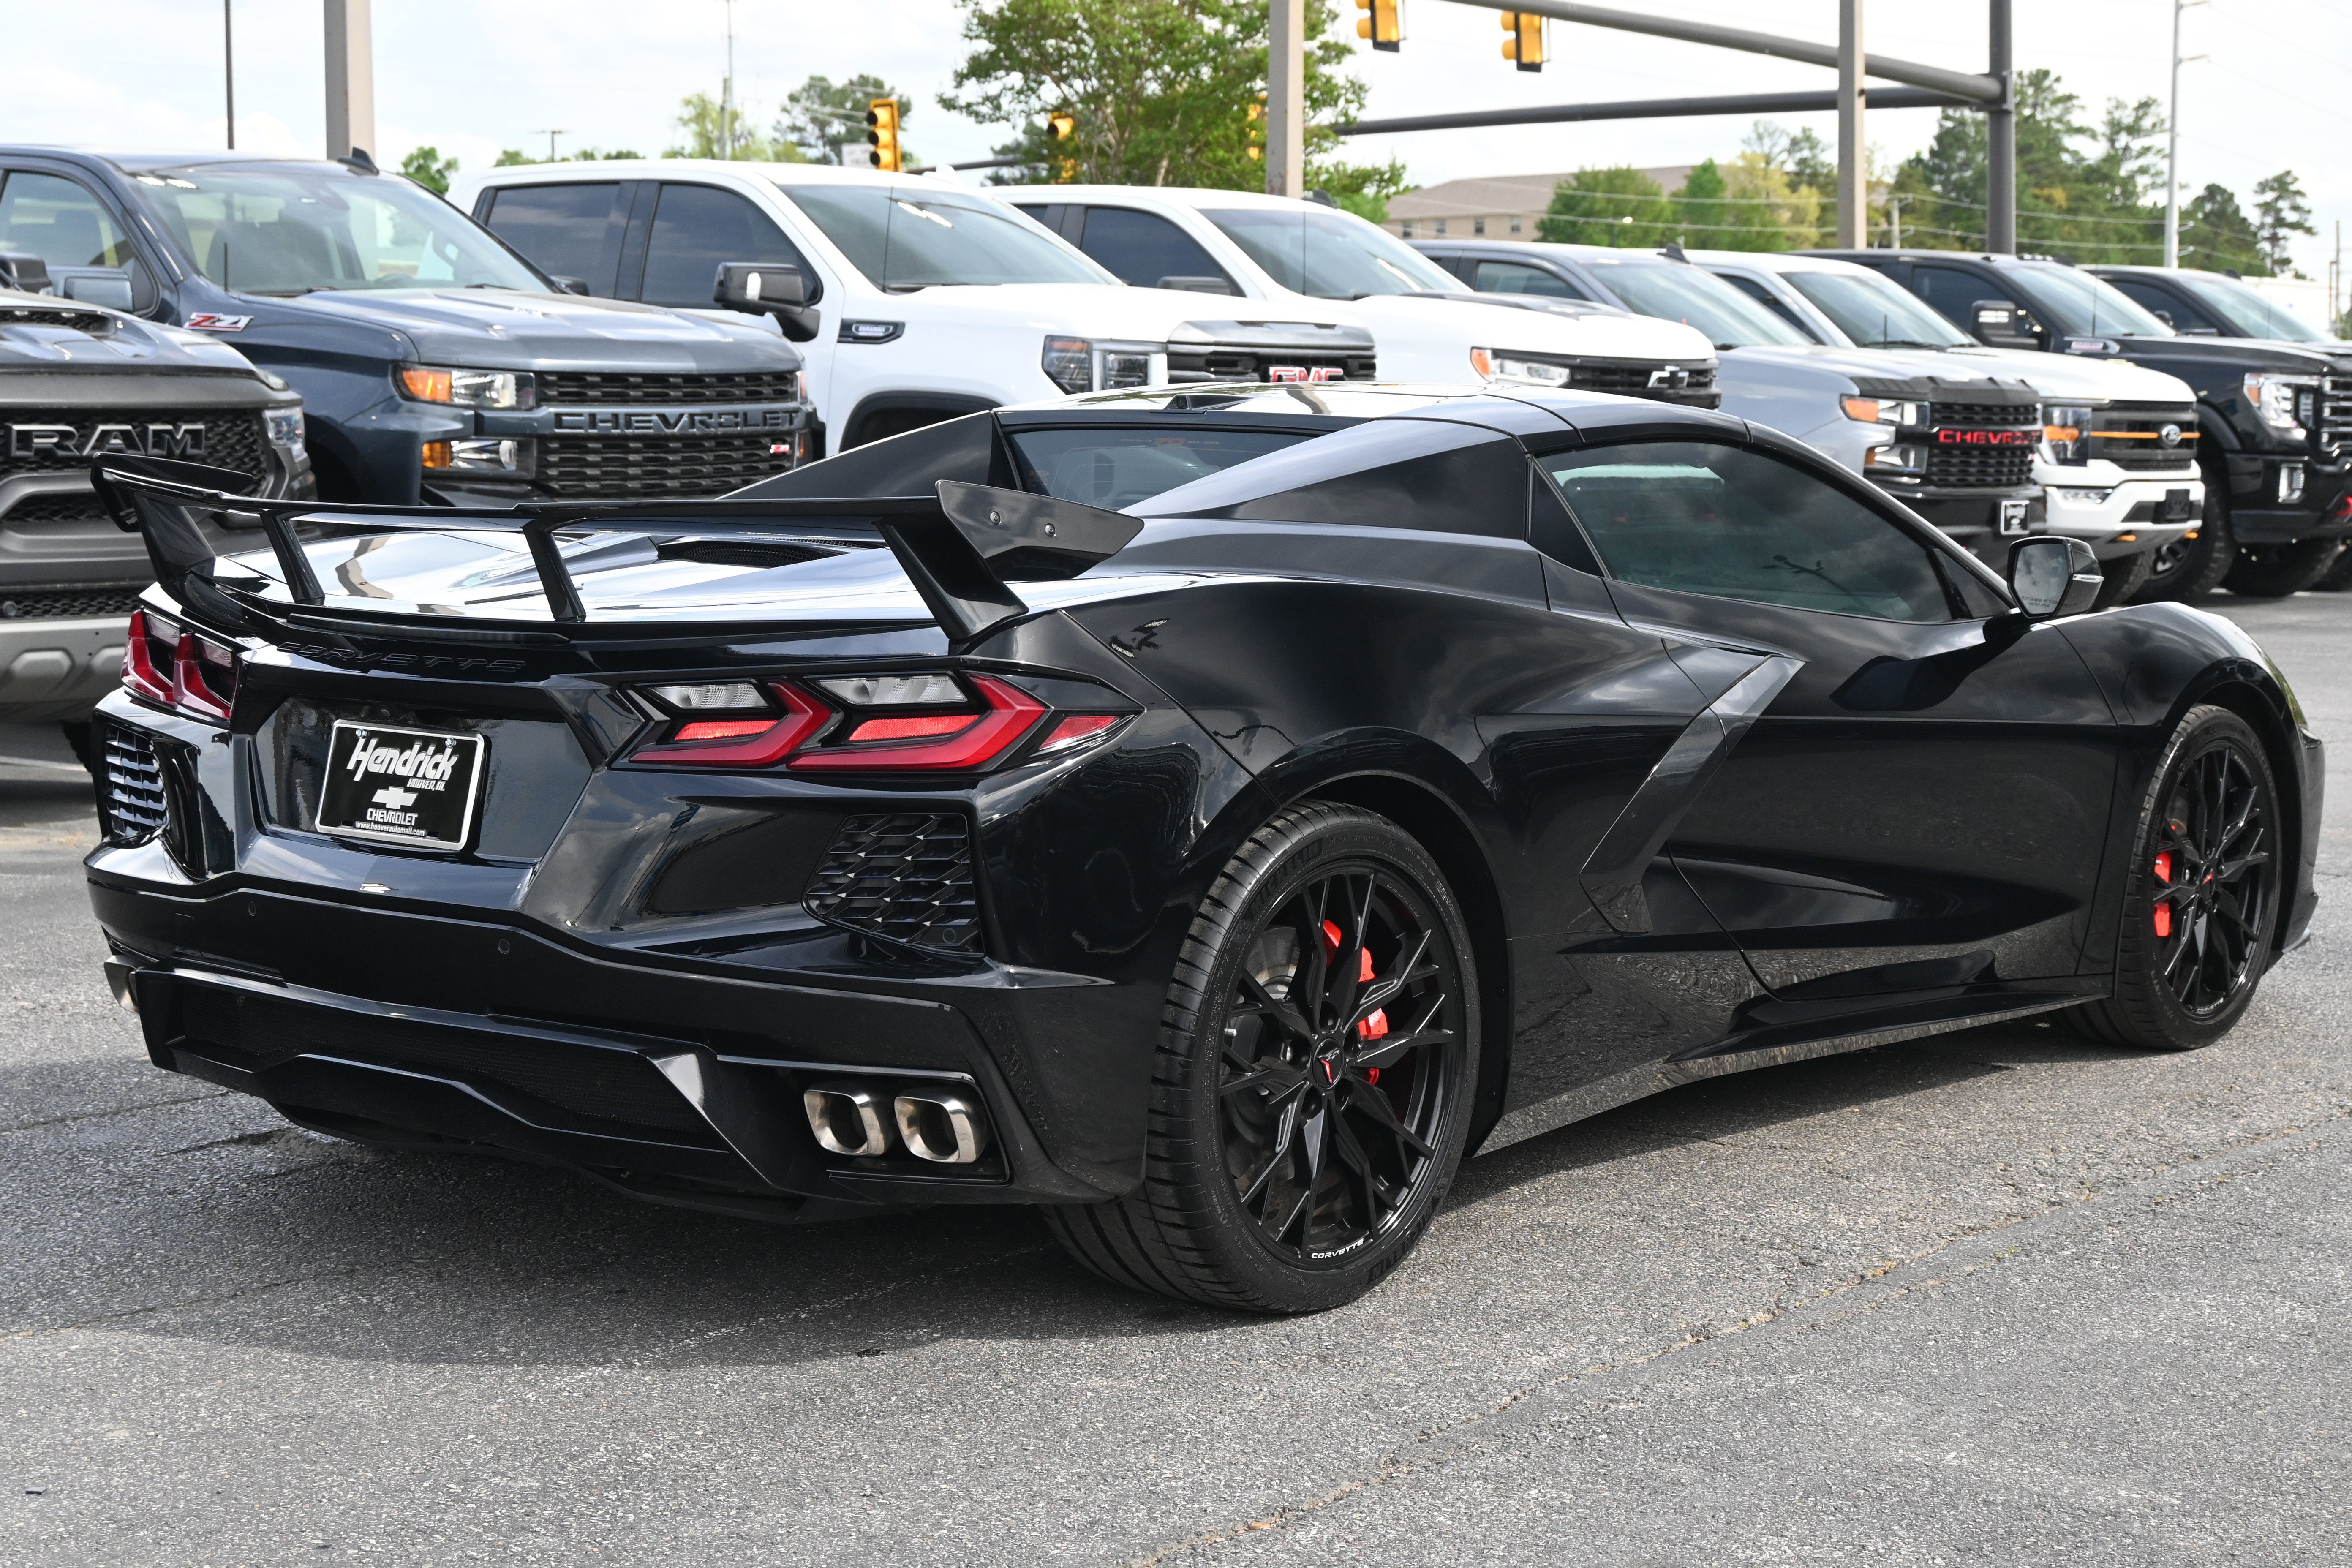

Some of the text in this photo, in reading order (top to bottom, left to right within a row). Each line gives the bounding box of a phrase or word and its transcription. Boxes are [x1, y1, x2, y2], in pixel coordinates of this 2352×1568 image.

[184, 312, 254, 332] Z71
[1269, 366, 1344, 382] GMC
[553, 410, 800, 433] CHEVROLET
[9, 424, 206, 456] RAM
[277, 642, 526, 672] CORVETTE
[346, 737, 459, 781] Hendrick
[406, 777, 445, 791] HOOVER, AL
[366, 807, 418, 826] CHEVROLET
[355, 821, 425, 837] www.hooverautomall.com
[1250, 842, 1319, 918] MICHELIN
[1387, 883, 1420, 917] FORGED
[1311, 1237, 1364, 1259] CORVETTE
